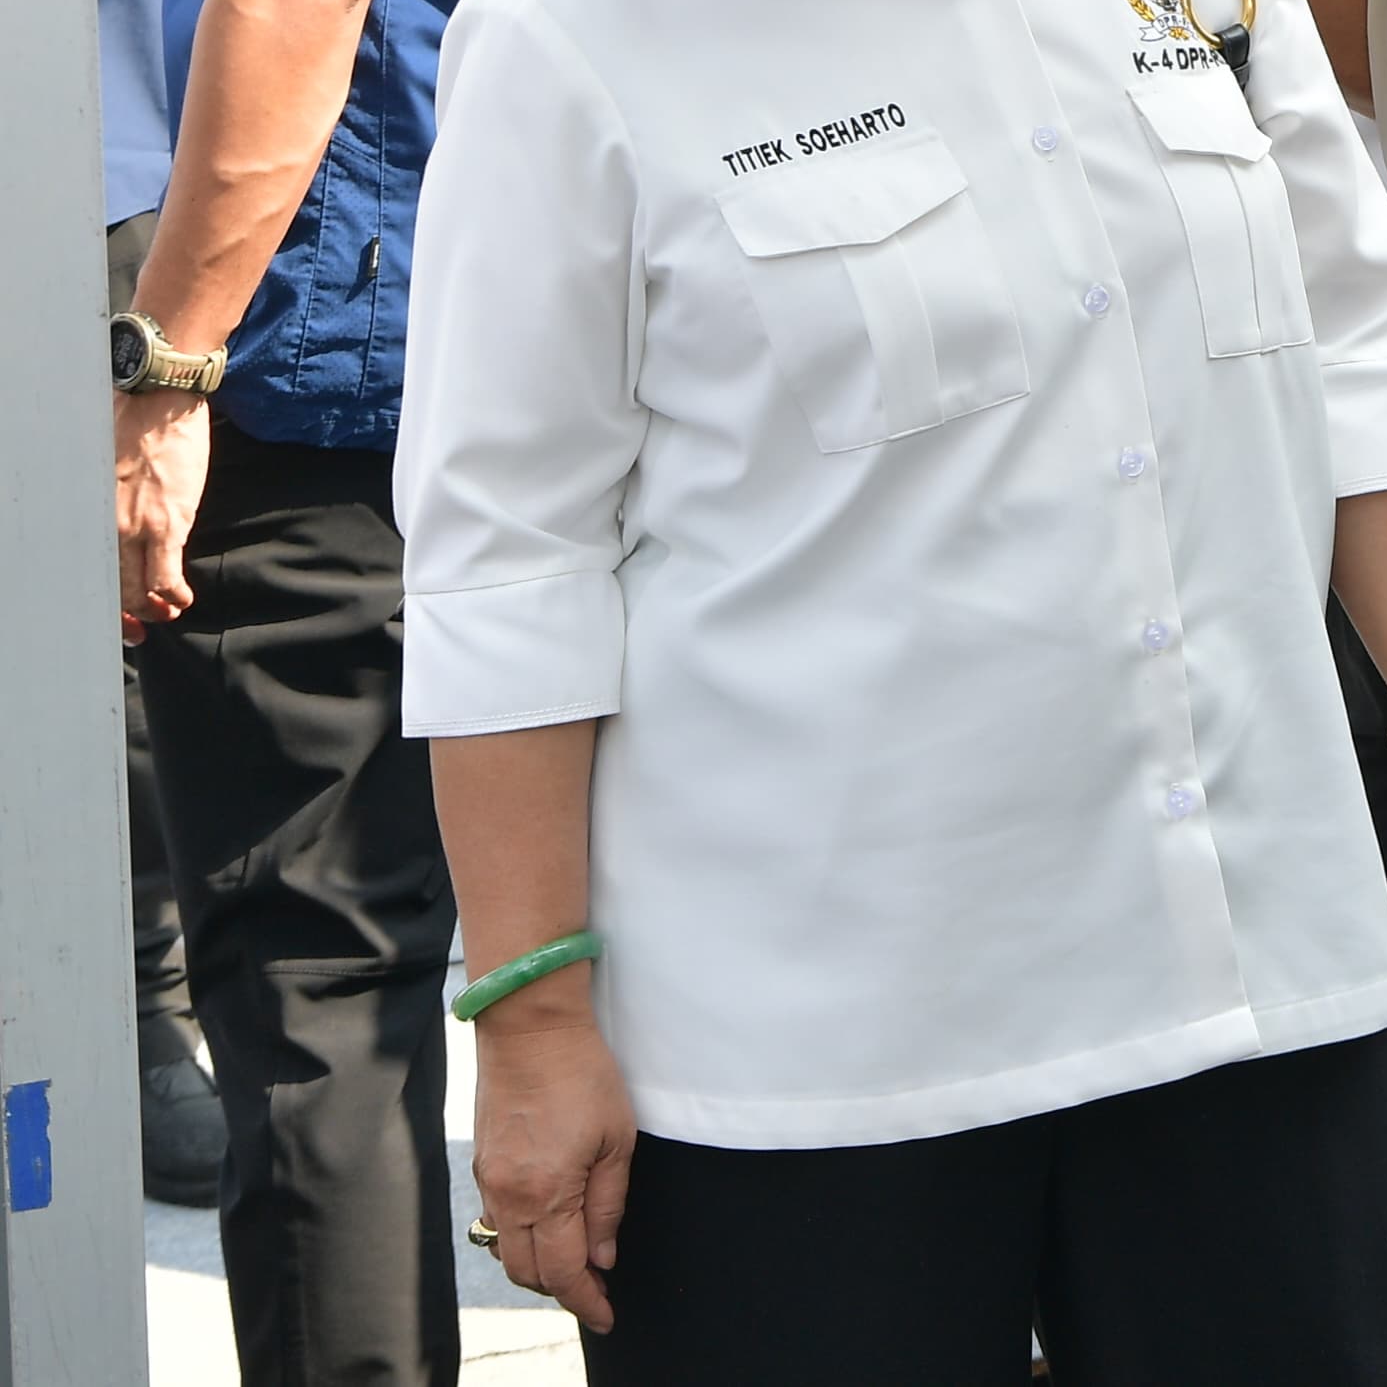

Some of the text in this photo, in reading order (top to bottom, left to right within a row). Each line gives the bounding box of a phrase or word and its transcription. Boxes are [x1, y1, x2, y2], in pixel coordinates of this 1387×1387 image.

[1132, 48, 1173, 74] K-4
[722, 103, 906, 177] TITIEK SOEHARTO
